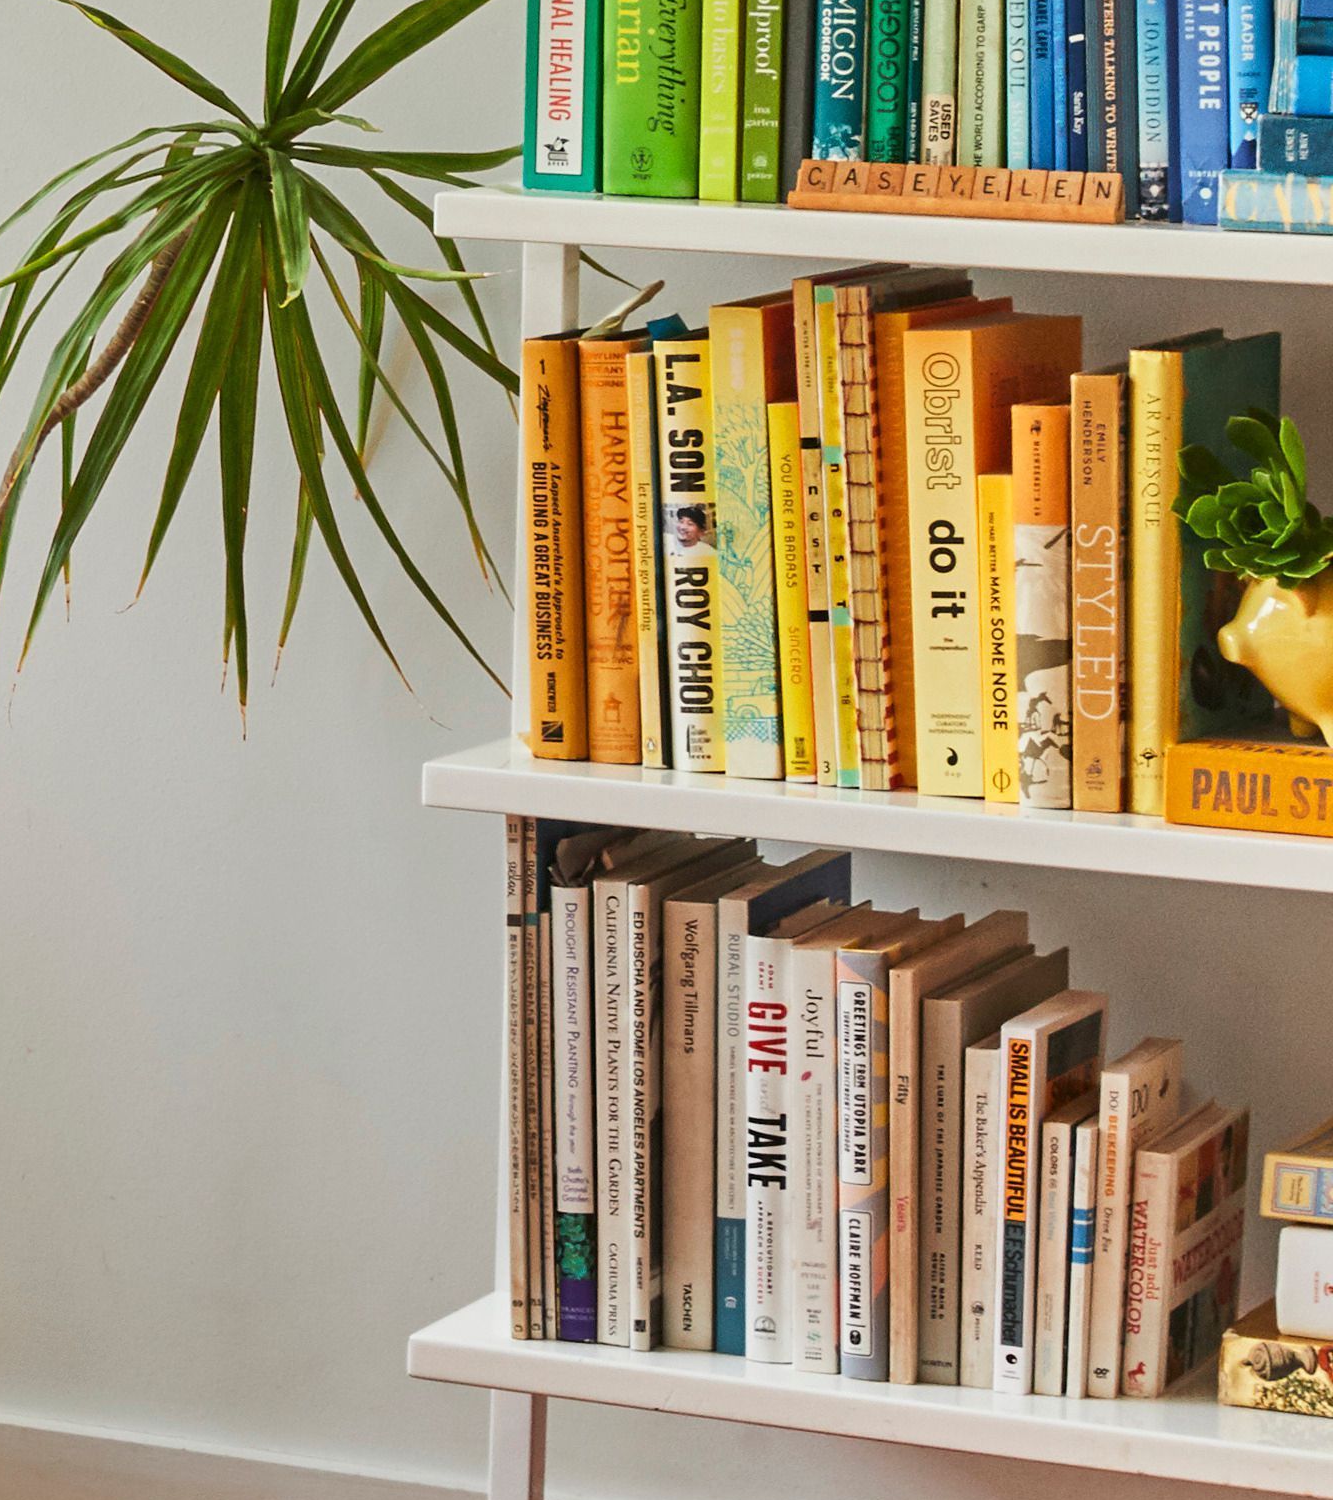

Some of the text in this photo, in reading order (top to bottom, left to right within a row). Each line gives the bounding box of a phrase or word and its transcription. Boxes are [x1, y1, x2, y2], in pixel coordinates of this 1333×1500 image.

[548, 39, 573, 121] HEALING
[819, 9, 832, 81] COOKBOOK
[1144, 18, 1161, 143] JOAN DIDION
[1198, 25, 1221, 110] PEOPLE
[929, 100, 940, 142] SAVES
[941, 103, 952, 140] USED
[665, 354, 705, 492] L.A. SON
[923, 352, 962, 490] Obrist
[1082, 401, 1093, 485] HENDERSON
[1096, 424, 1106, 462] EMILY
[532, 462, 552, 660] BUILDING A GREAT BUSINESS
[635, 482, 653, 631] let my people go surfing
[928, 519, 966, 618] do it
[675, 568, 713, 714] ROY CHOI
[990, 576, 1008, 730] MAKE SOME NOISE
[1075, 525, 1115, 720] STYLED
[1192, 768, 1277, 816] PAUL
[606, 983, 621, 1034] NATIVE
[681, 920, 698, 1053] Wolfgang Tillmans
[801, 989, 824, 1059] Joyful
[606, 1039, 622, 1091] PLANTS
[633, 912, 646, 1238] ED RUSCHA AND SOME LOS ANGELES APARTMENTS
[747, 1002, 787, 1075] GIVE
[607, 1096, 621, 1121] FOR
[853, 991, 867, 1174] GREETINGS FROM UTOPIA PARK
[607, 1125, 621, 1153] THE
[747, 1114, 787, 1190] TAKE
[1005, 1042, 1029, 1216] SMALL IS BEAUTIFUL
[607, 1159, 622, 1217] GARDEN
[682, 1283, 692, 1331] TASCHEN
[848, 1218, 863, 1319] CLAIRE HOFFMAN
